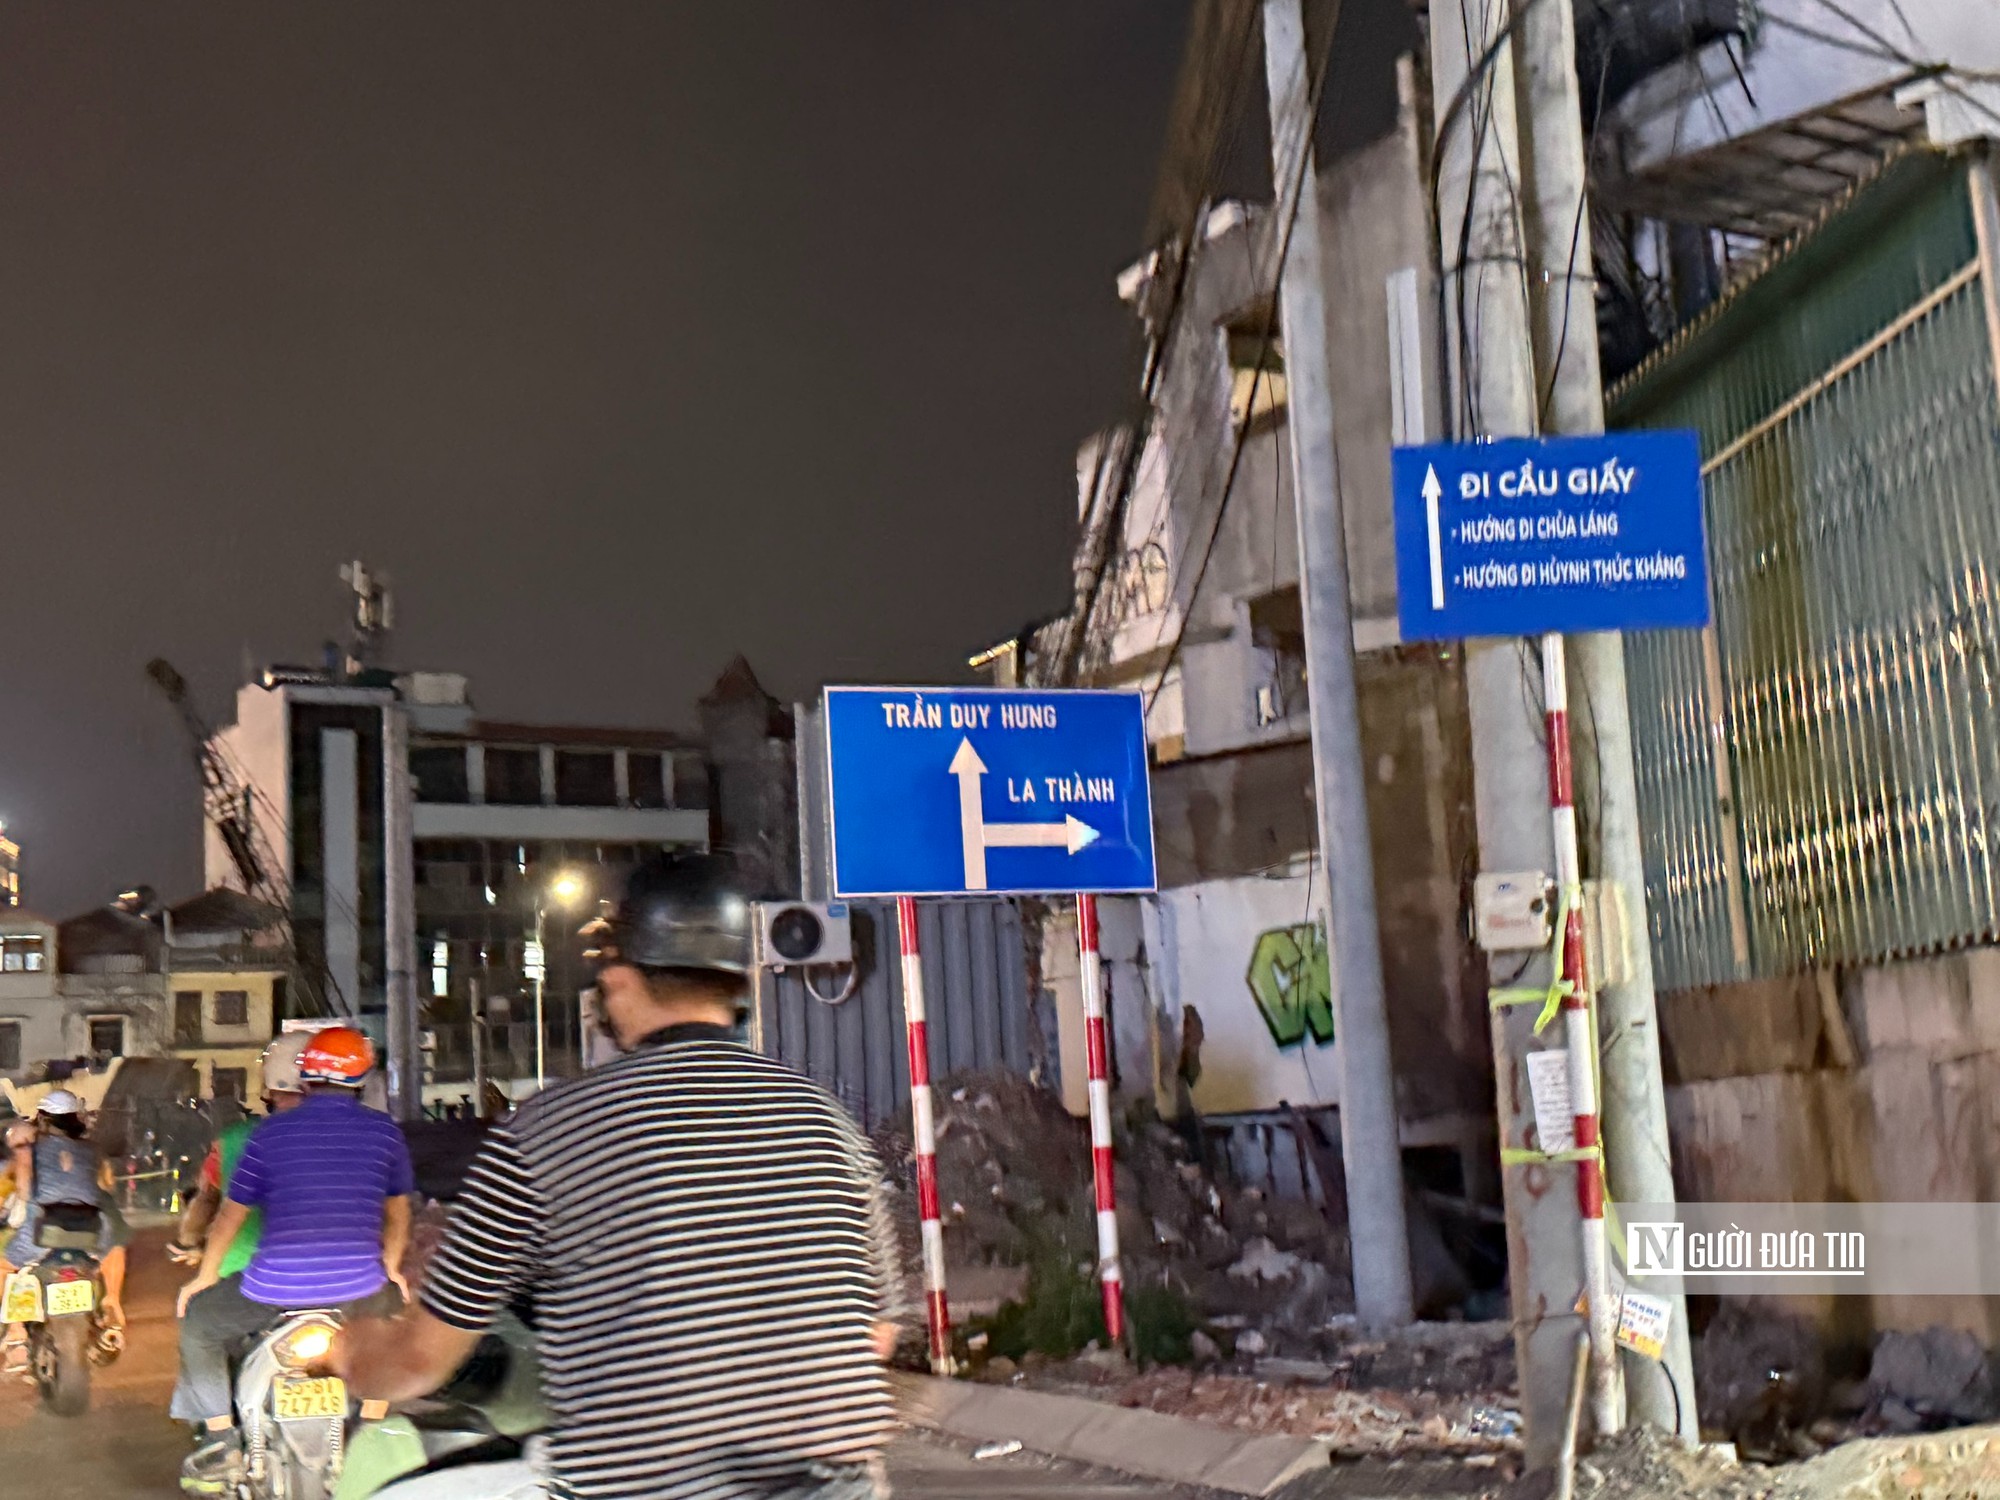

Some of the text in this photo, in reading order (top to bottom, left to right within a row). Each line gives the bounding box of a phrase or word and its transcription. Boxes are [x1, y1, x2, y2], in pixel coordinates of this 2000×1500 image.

[1459, 456, 1635, 500] ĐI CẦU GIẤY
[1461, 513, 1516, 544] HƯỚNG
[1537, 509, 1577, 540] CHÙA
[1580, 508, 1618, 538] LÁNG
[1463, 558, 1518, 590] HƯỚNG
[1592, 551, 1633, 583] THÚC
[1634, 549, 1686, 580] KHÁNG
[881, 692, 942, 729] TRẦN
[950, 702, 991, 729] DUY
[1007, 769, 1115, 803] LA THÀNH
